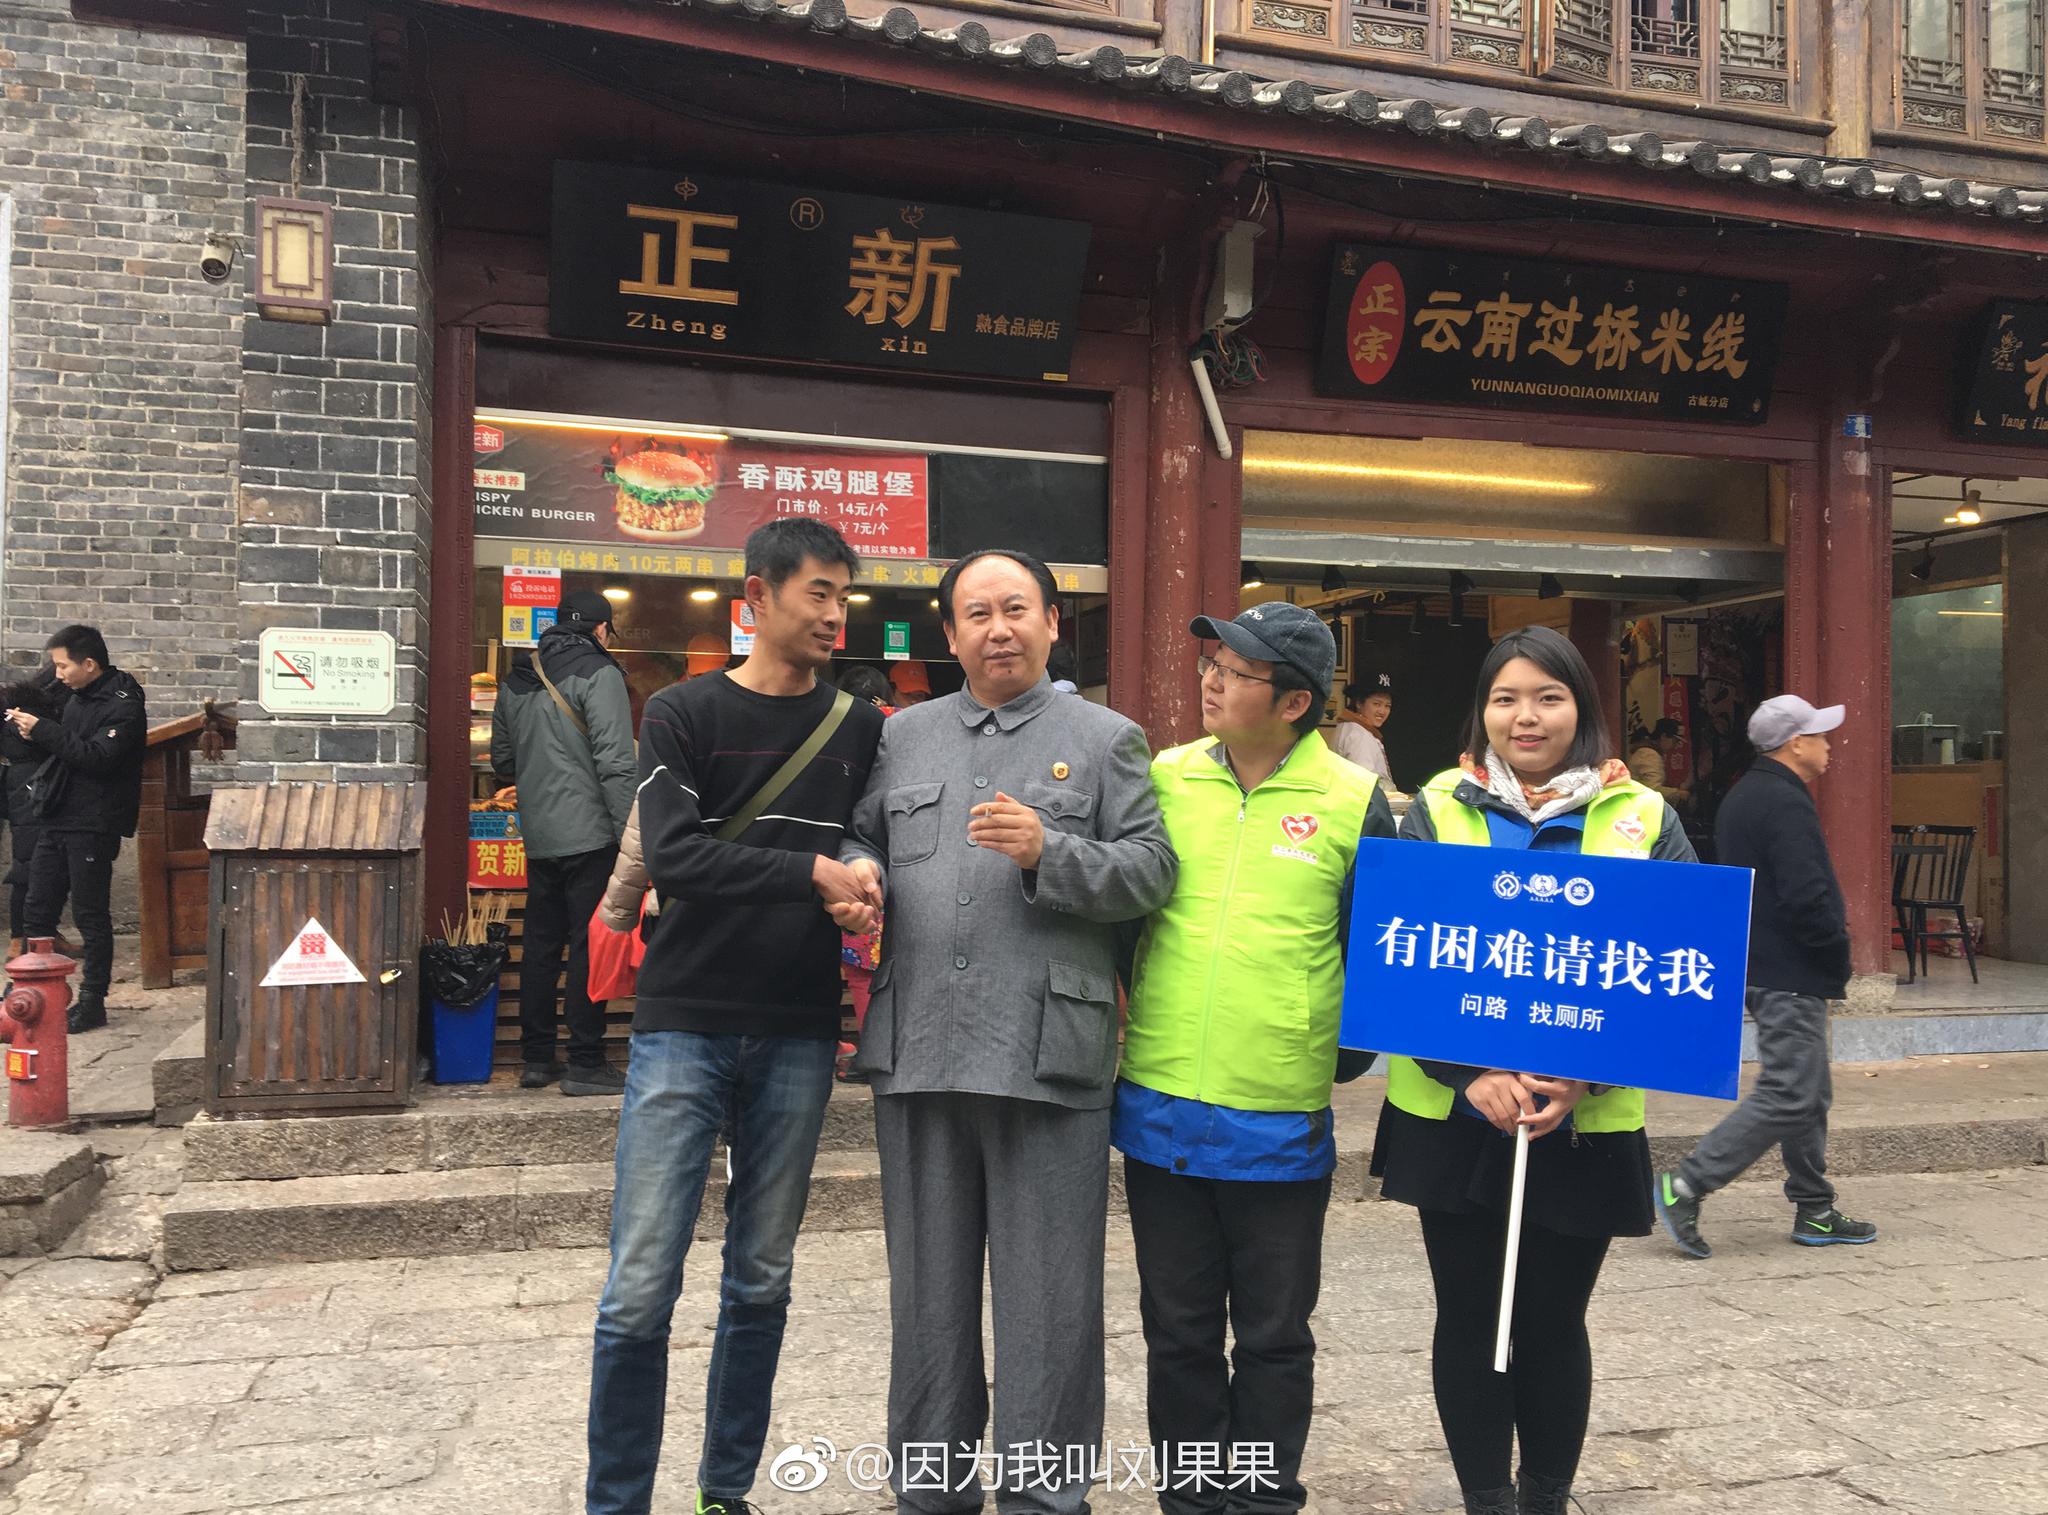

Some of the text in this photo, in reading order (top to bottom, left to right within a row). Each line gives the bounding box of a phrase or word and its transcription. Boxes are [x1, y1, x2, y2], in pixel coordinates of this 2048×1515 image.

[619, 203, 739, 306] 正
[844, 228, 963, 332] 新
[627, 310, 729, 341] Zheng
[975, 312, 1061, 341] 熟食品牌店
[1353, 283, 1400, 364] 正宗
[1413, 289, 1749, 380] 云南过桥米线
[880, 334, 928, 356] xin
[1470, 377, 1661, 405] YUNNANGUOQIAOMIXIAN
[1687, 395, 1730, 410] 古城分店
[2001, 413, 2028, 431] Yang
[737, 463, 915, 497] 香酥鸡腿堡
[475, 491, 511, 504] ISPY
[531, 508, 596, 523] BURGER
[511, 547, 620, 571] 阿拉伯烤肉
[629, 555, 715, 575] 10元两串
[320, 655, 380, 670] 请勿吸烟
[322, 668, 376, 680] No Smoking
[1374, 916, 1717, 1001] 有困难请找我
[1460, 993, 1605, 1033] 问路 找厕所
